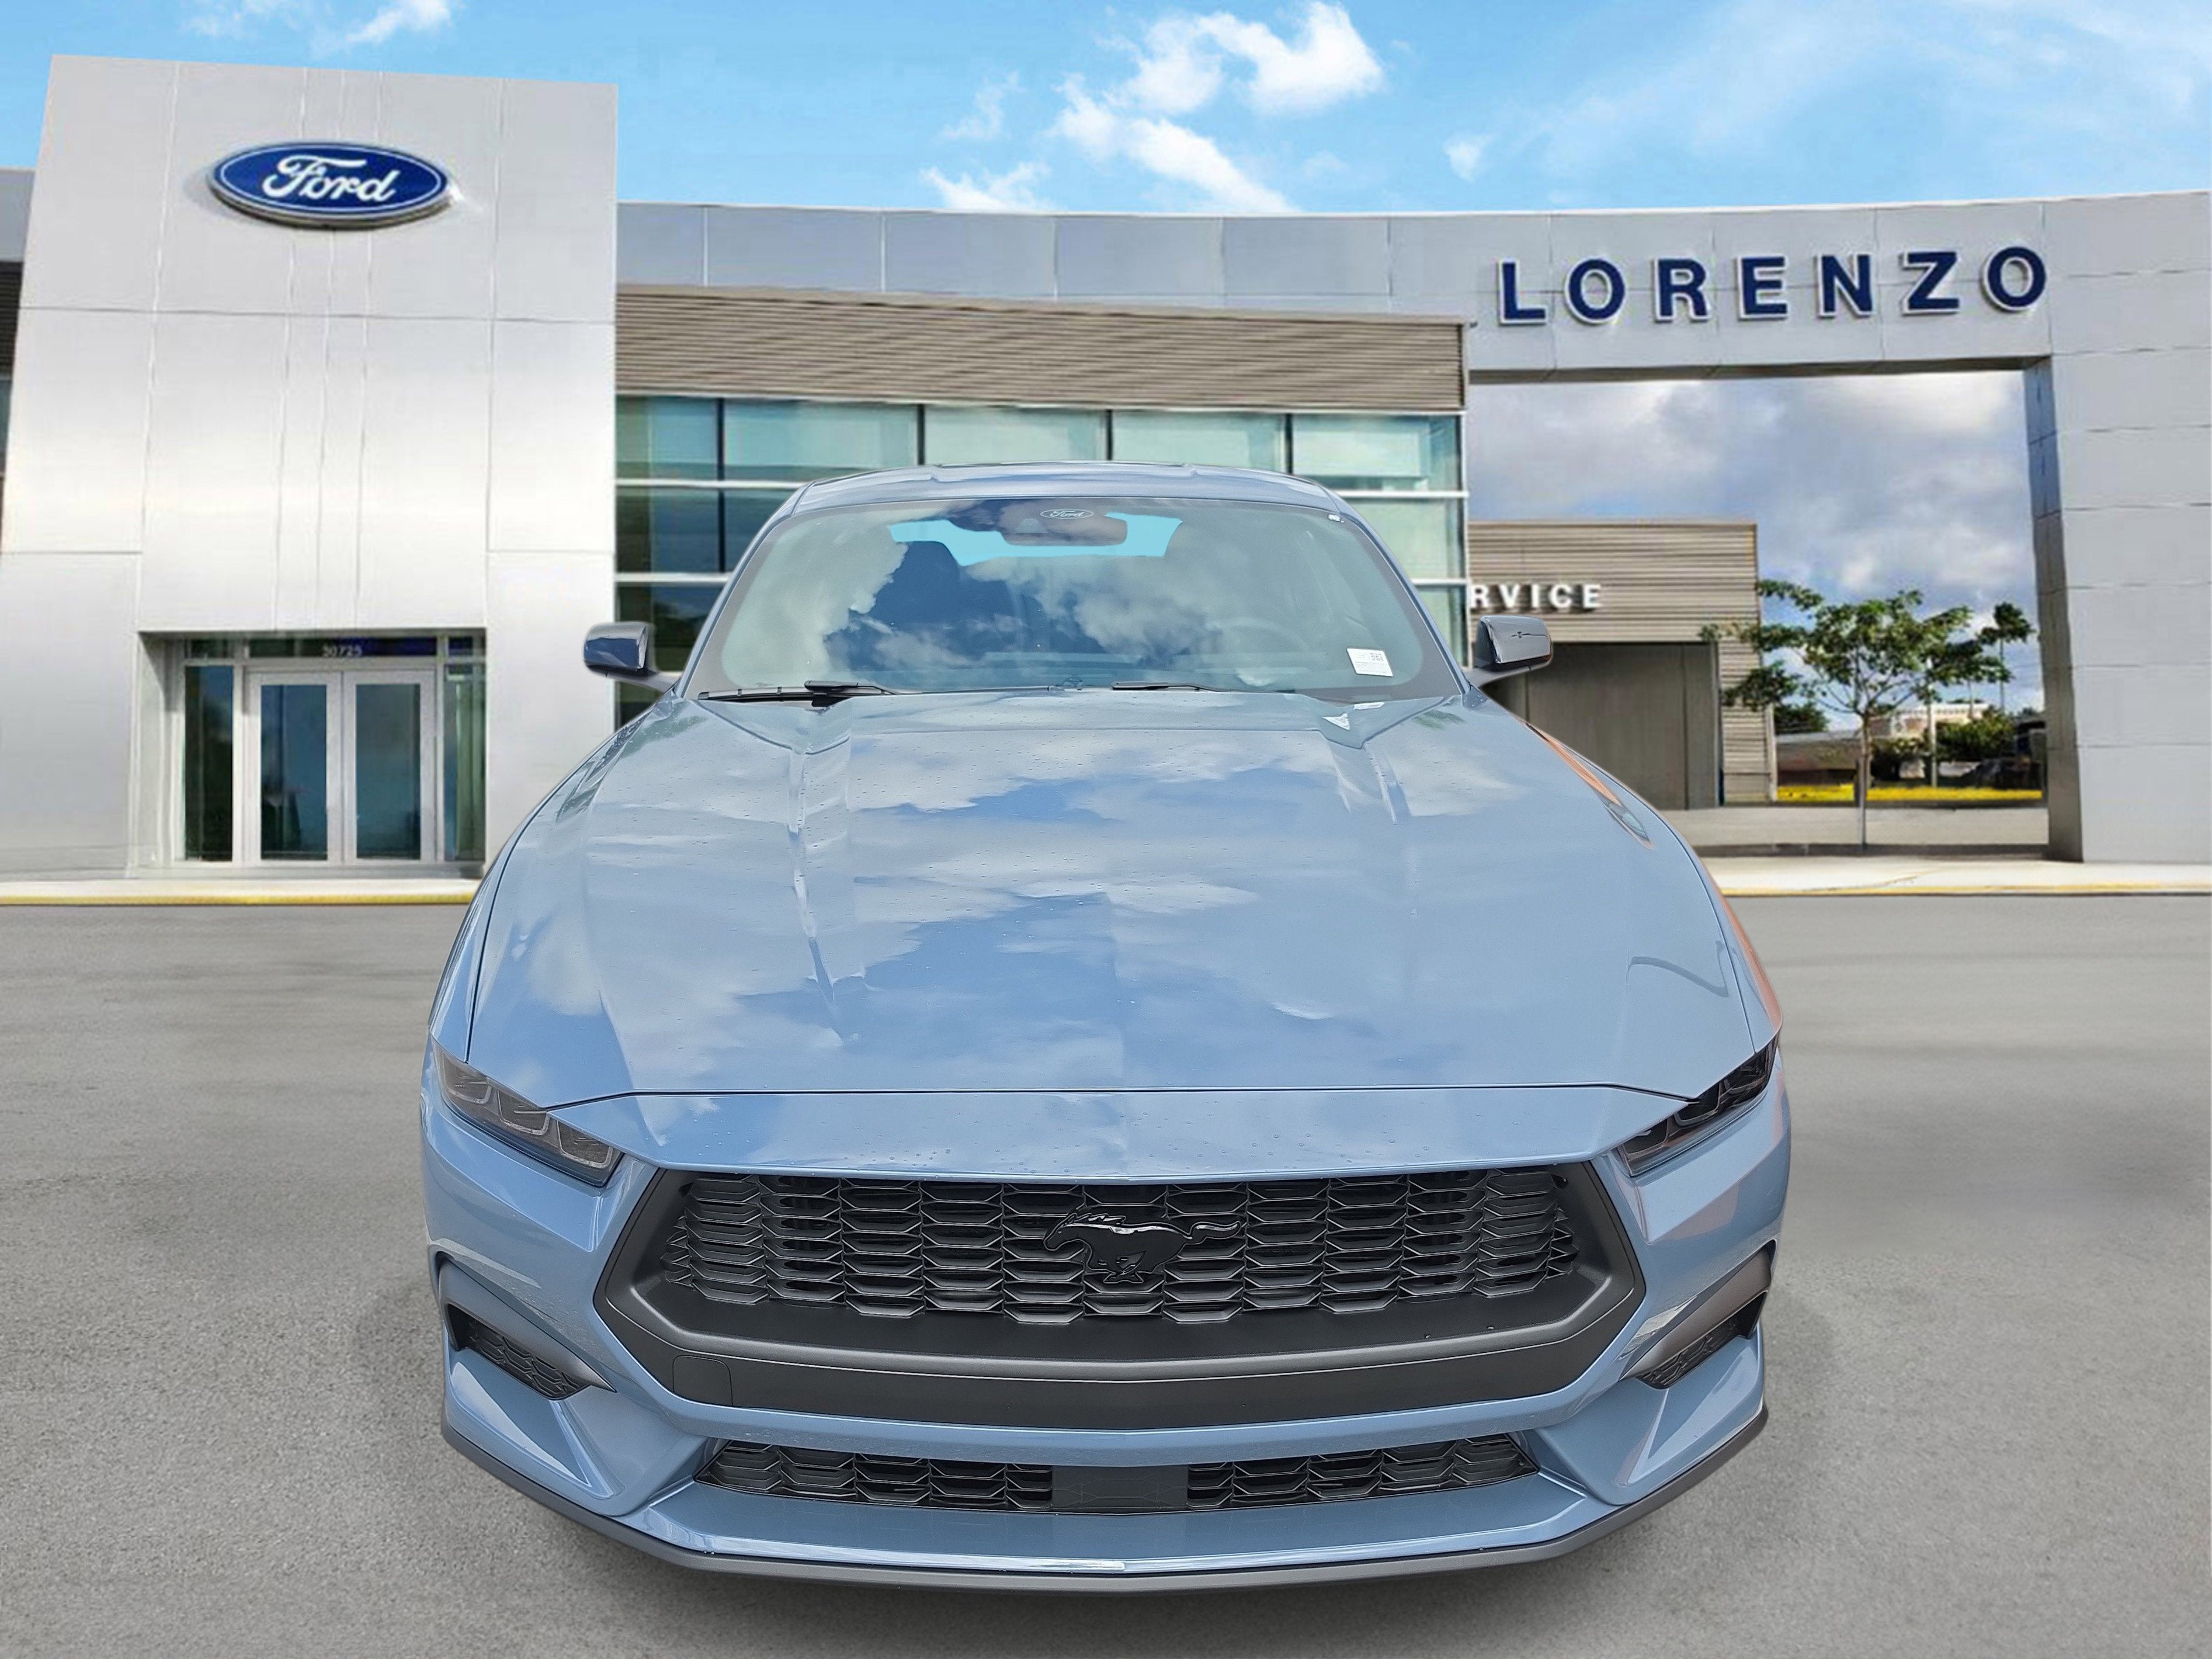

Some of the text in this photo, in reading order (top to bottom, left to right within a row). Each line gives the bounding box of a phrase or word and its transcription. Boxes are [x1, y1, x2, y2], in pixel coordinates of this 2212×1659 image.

[262, 154, 400, 202] Ford
[1498, 246, 2047, 325] LORENZO
[1470, 584, 1602, 609] RVICE
